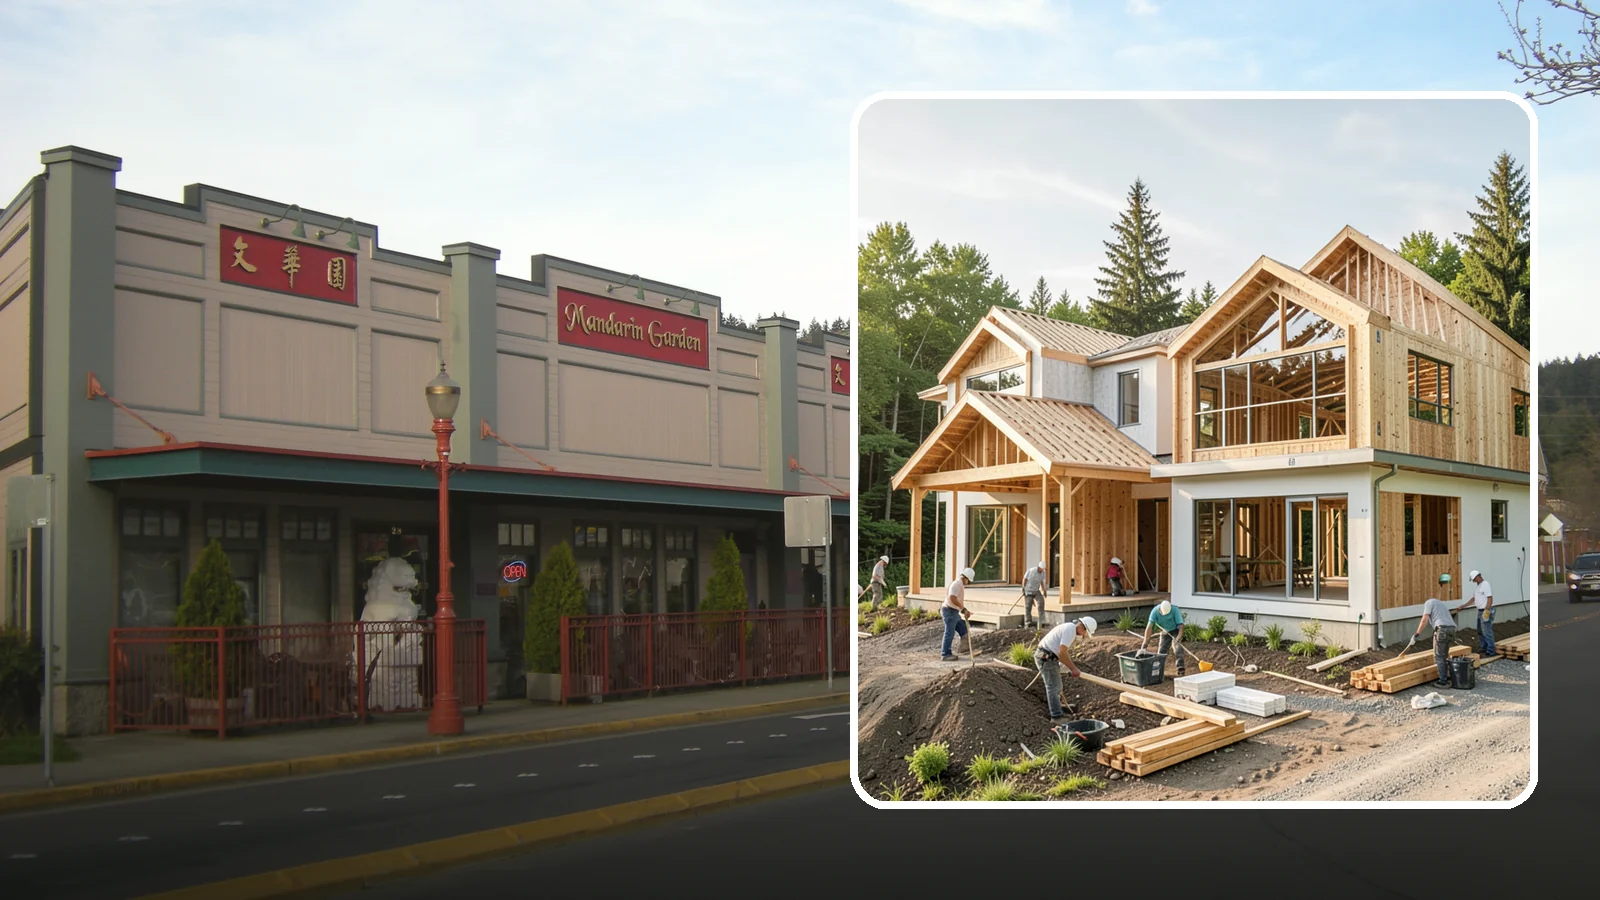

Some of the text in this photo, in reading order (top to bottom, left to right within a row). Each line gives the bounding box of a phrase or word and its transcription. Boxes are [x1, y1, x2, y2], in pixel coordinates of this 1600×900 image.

[231, 235, 346, 291] 文華園
[564, 302, 702, 352] Mandarin Garden
[503, 565, 527, 578] OPEN
